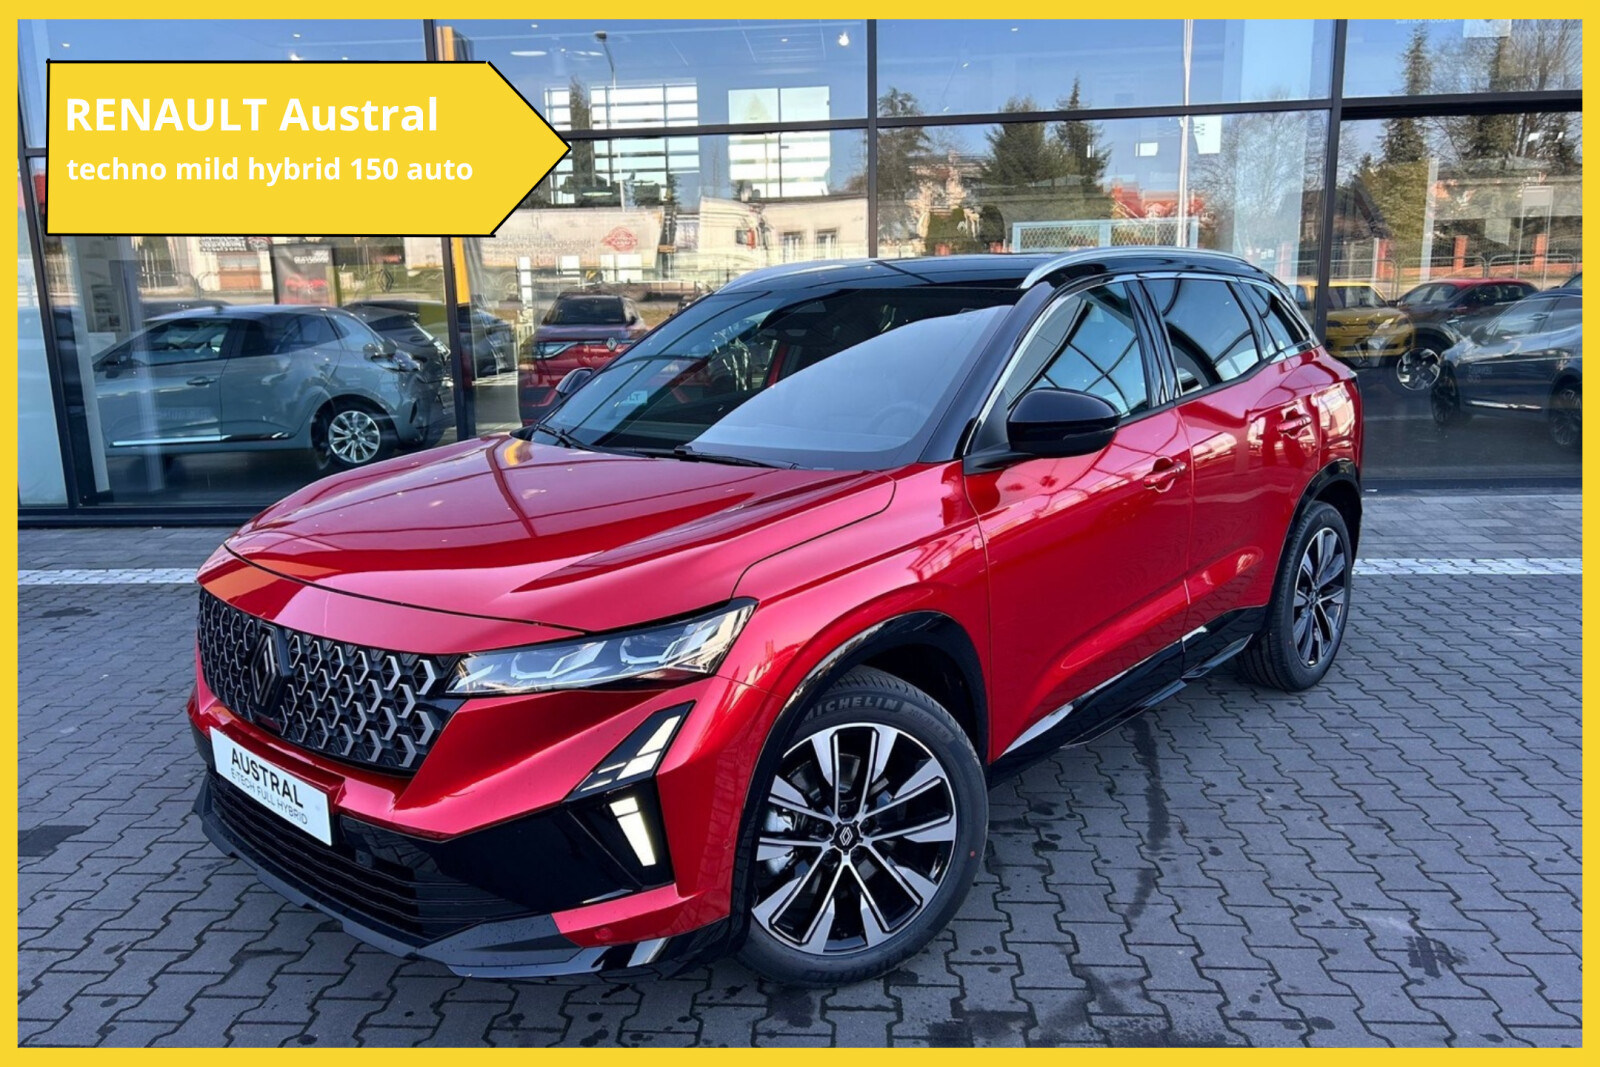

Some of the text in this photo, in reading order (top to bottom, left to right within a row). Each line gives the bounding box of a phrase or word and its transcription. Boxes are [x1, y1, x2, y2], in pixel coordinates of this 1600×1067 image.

[803, 696, 898, 721] MICHELIN
[231, 748, 304, 808] AUSTRAL
[257, 786, 275, 806] FULL
[276, 799, 307, 824] HYBRID
